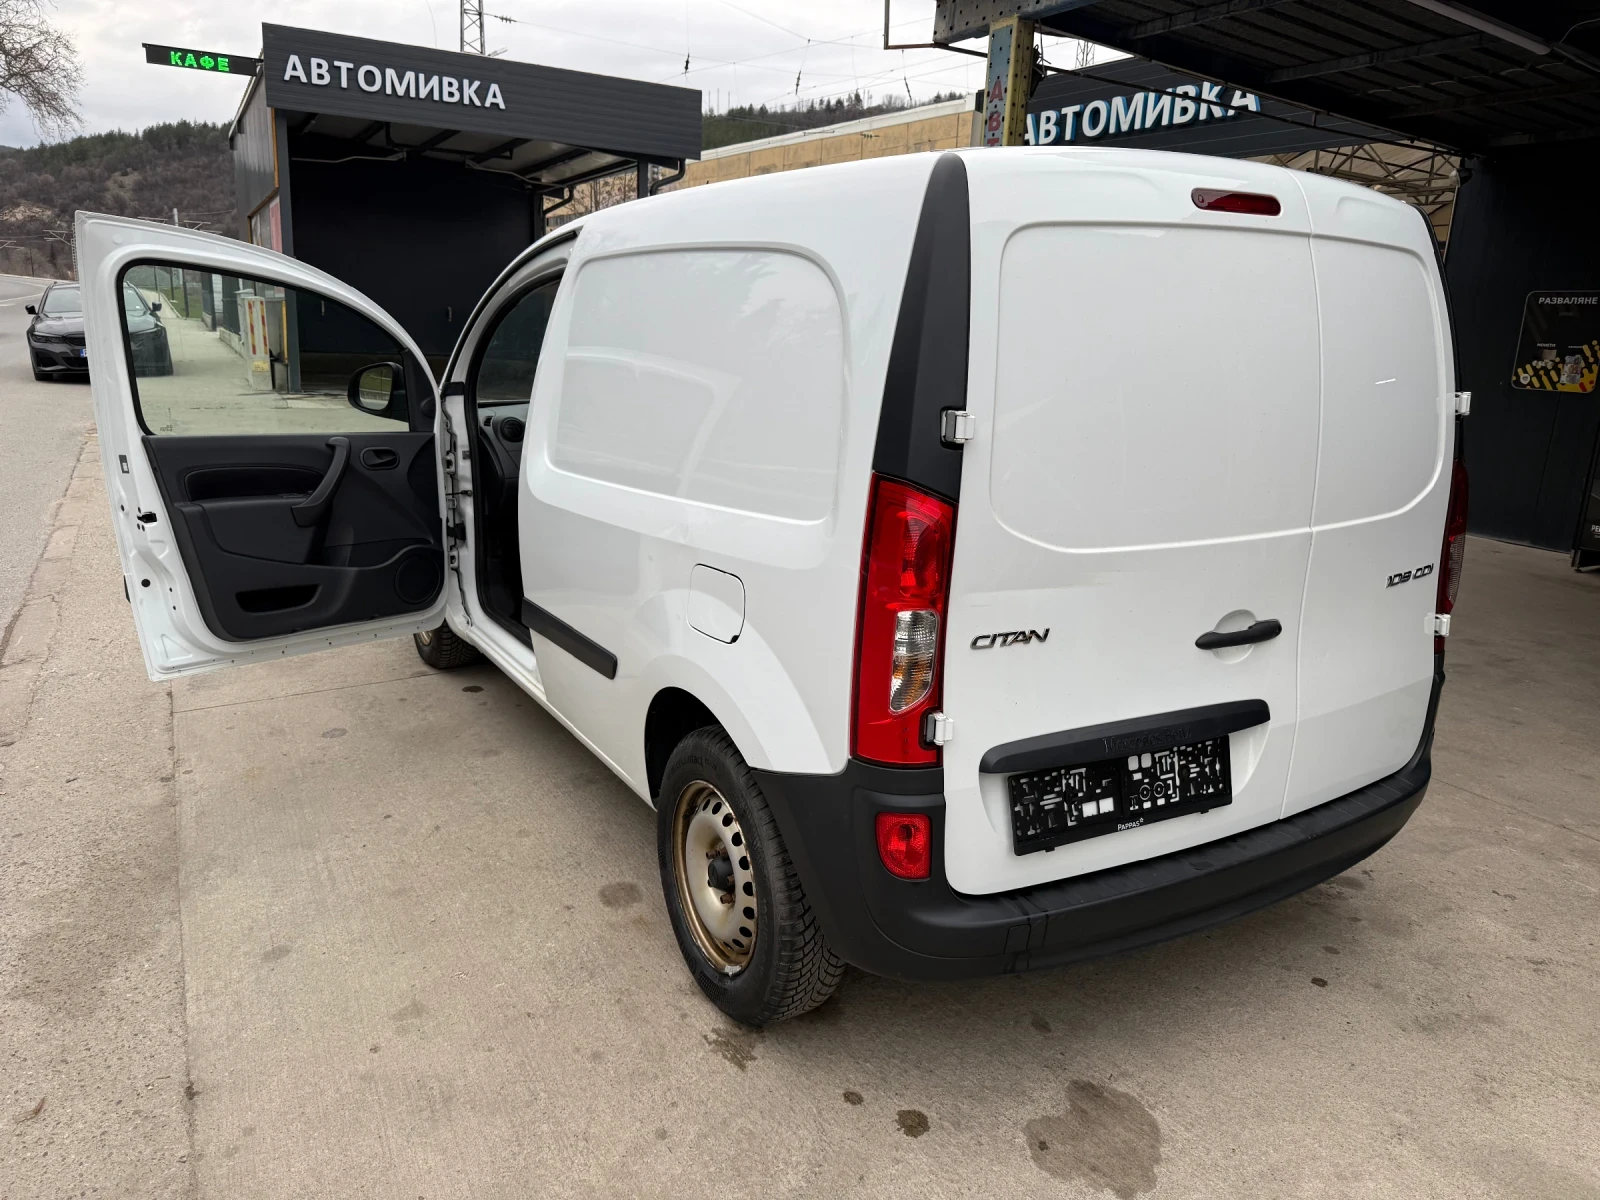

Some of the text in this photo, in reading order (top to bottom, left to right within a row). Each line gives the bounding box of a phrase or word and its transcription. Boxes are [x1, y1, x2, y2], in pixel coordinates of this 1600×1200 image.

[170, 51, 230, 72] КАФЕ
[283, 54, 506, 110] АВТОМИВКА
[1538, 296, 1599, 306] РАЗВАЛЯНЕ
[970, 627, 1050, 650] CITAN
